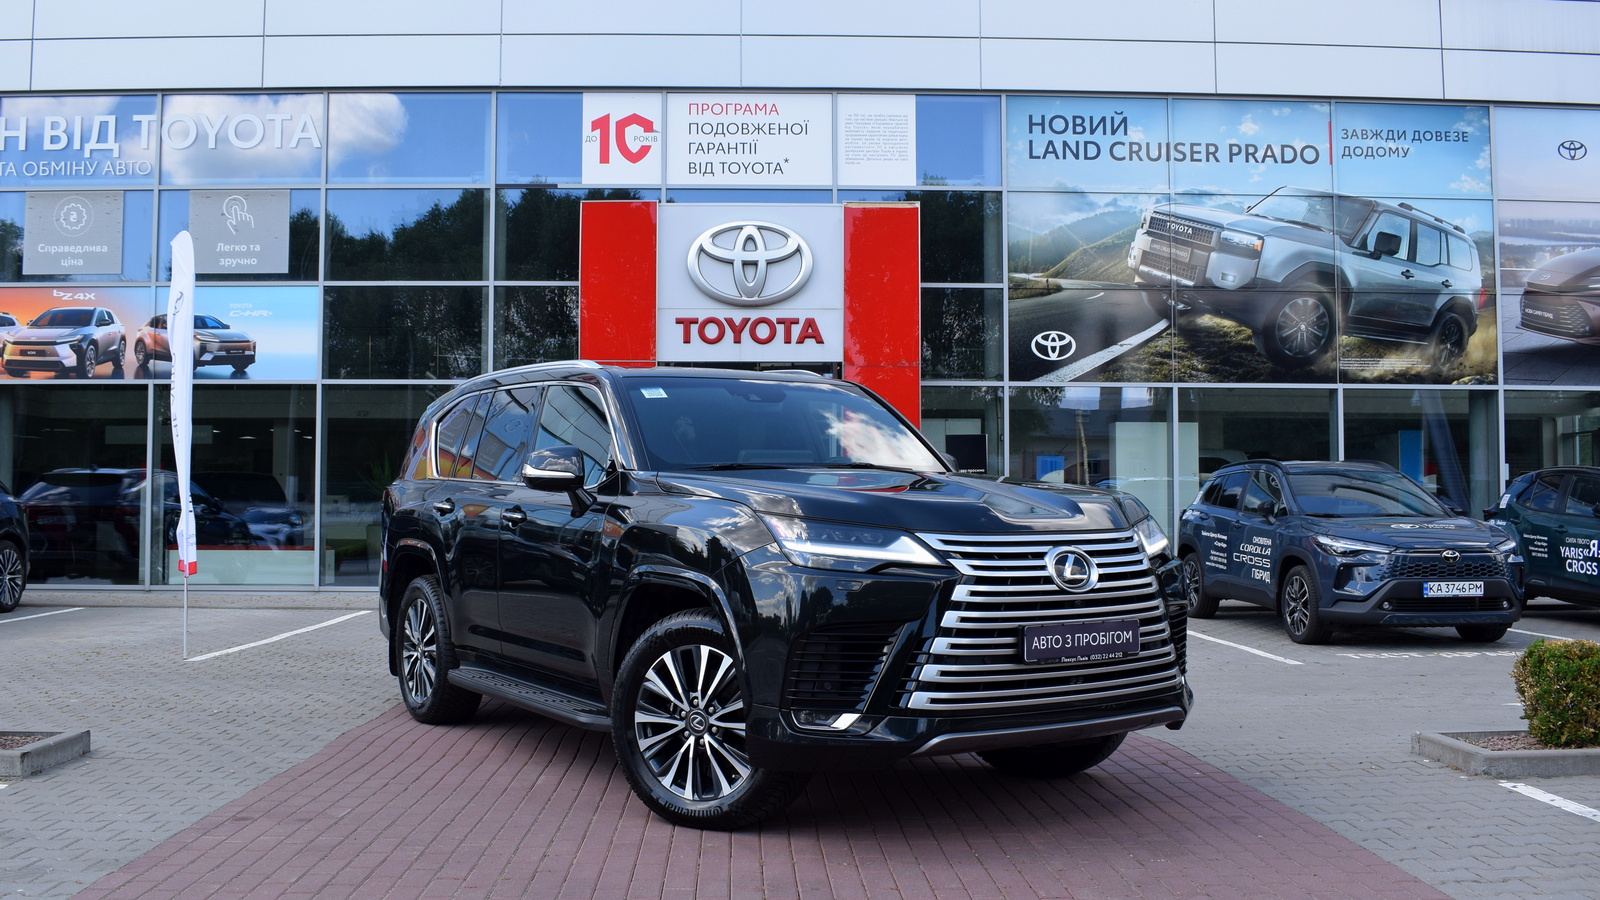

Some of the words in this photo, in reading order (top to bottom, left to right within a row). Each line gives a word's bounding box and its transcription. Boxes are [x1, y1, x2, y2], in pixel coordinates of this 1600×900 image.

[688, 103, 779, 116] ПРОГРАМА
[688, 120, 809, 137] ПОДОВЖЕНОЇ
[1027, 111, 1128, 136] НОВИЙ
[43, 115, 121, 158] ВІД
[132, 114, 323, 151] TOYOTA
[585, 135, 597, 143] ДО
[591, 113, 653, 165] 10
[1341, 127, 1407, 142] ЗАВЖДИ
[1411, 130, 1470, 144] ДОВЕЗЕ
[688, 140, 757, 155] ГАРАНТІЇ
[1028, 139, 1101, 160] LAND
[1109, 141, 1221, 164] CRUISER
[1228, 143, 1320, 165] PRADO
[1341, 145, 1411, 160] ДОДОМУ
[22, 161, 98, 177] ОБМІНУ
[102, 160, 152, 175] АВТО
[688, 162, 714, 177] ВІД
[1166, 222, 1192, 235] TOYOTA
[37, 243, 108, 256] Справедлива
[216, 243, 247, 252] Легко
[249, 244, 261, 252] та
[60, 256, 84, 268] ціна
[219, 257, 258, 267] зручно
[675, 317, 824, 344] TOYOTA
[1239, 543, 1272, 556] COROLLA
[1559, 545, 1584, 560] YARIS
[1232, 552, 1271, 568] CROSS
[1565, 559, 1598, 576] CROSS
[1428, 583, 1443, 594] KA
[1444, 583, 1467, 593] 3746
[1468, 583, 1483, 593] PM
[1031, 635, 1063, 650] АВТО
[1074, 630, 1133, 647] ПРОБІГОМ
